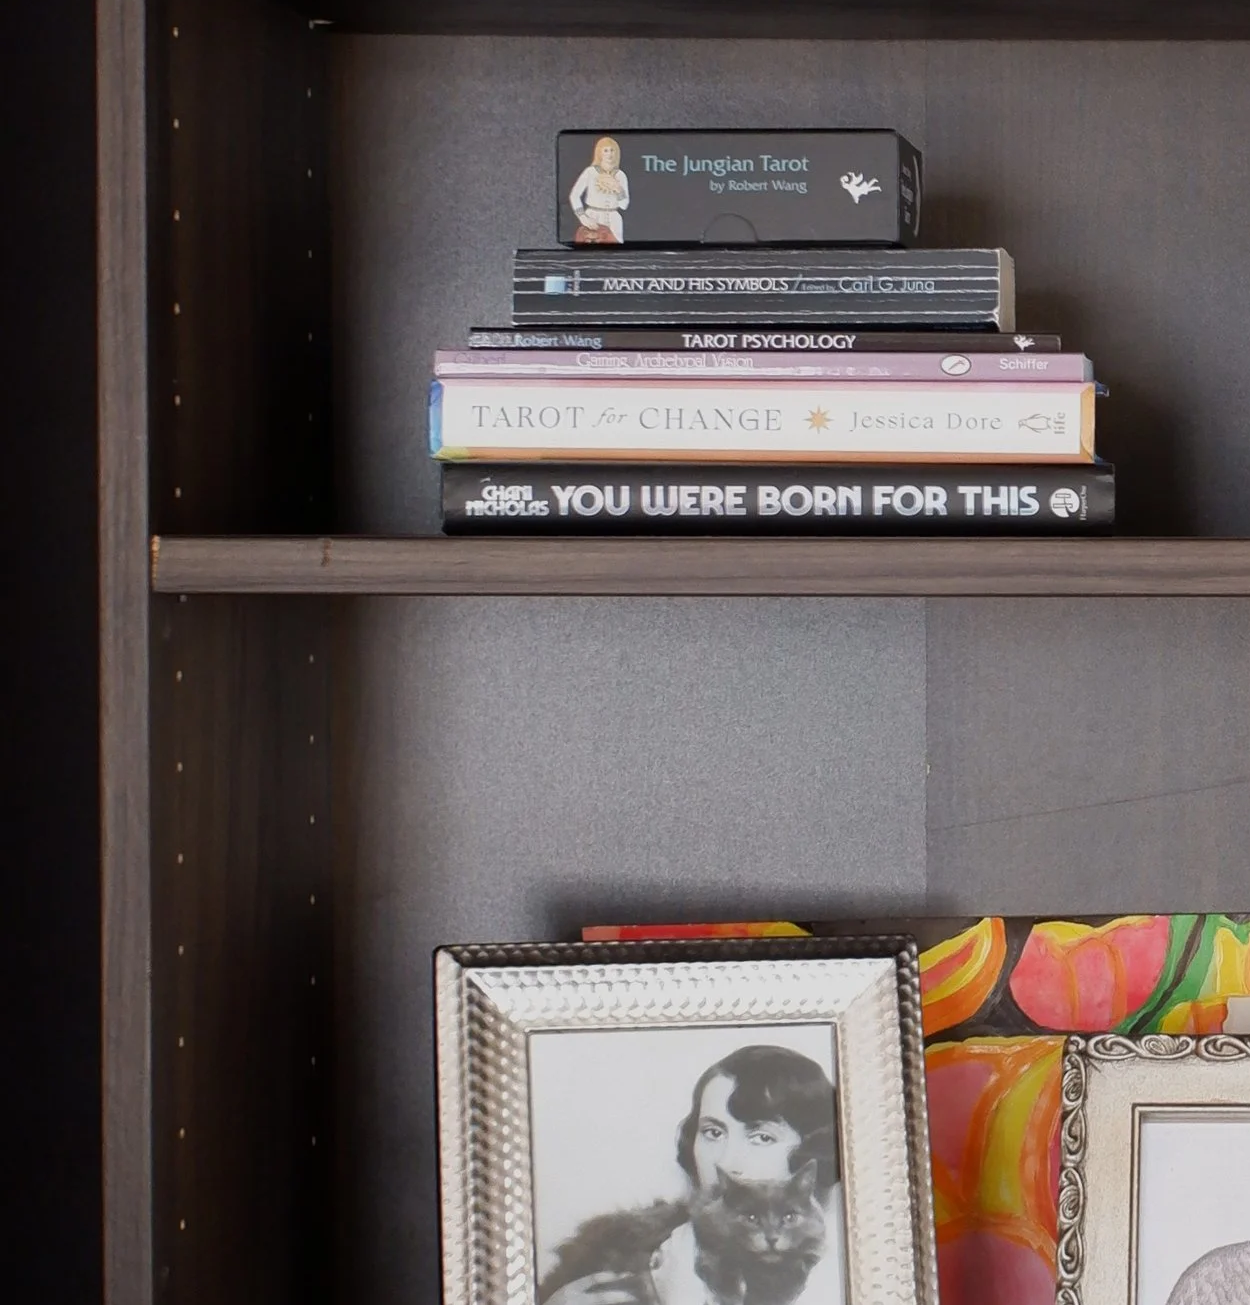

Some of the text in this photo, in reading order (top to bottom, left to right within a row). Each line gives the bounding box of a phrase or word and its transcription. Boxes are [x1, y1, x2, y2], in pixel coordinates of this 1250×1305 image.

[640, 154, 810, 178] The Jungian Tarot
[709, 179, 809, 195] by Robert Wang
[681, 334, 857, 350] TAROT PSYCHOLOGY
[471, 404, 782, 432] TAROT for CHANGE
[848, 410, 1002, 433] Jessica Dore
[550, 485, 1040, 517] YOU WERE BORN FOR THIS
